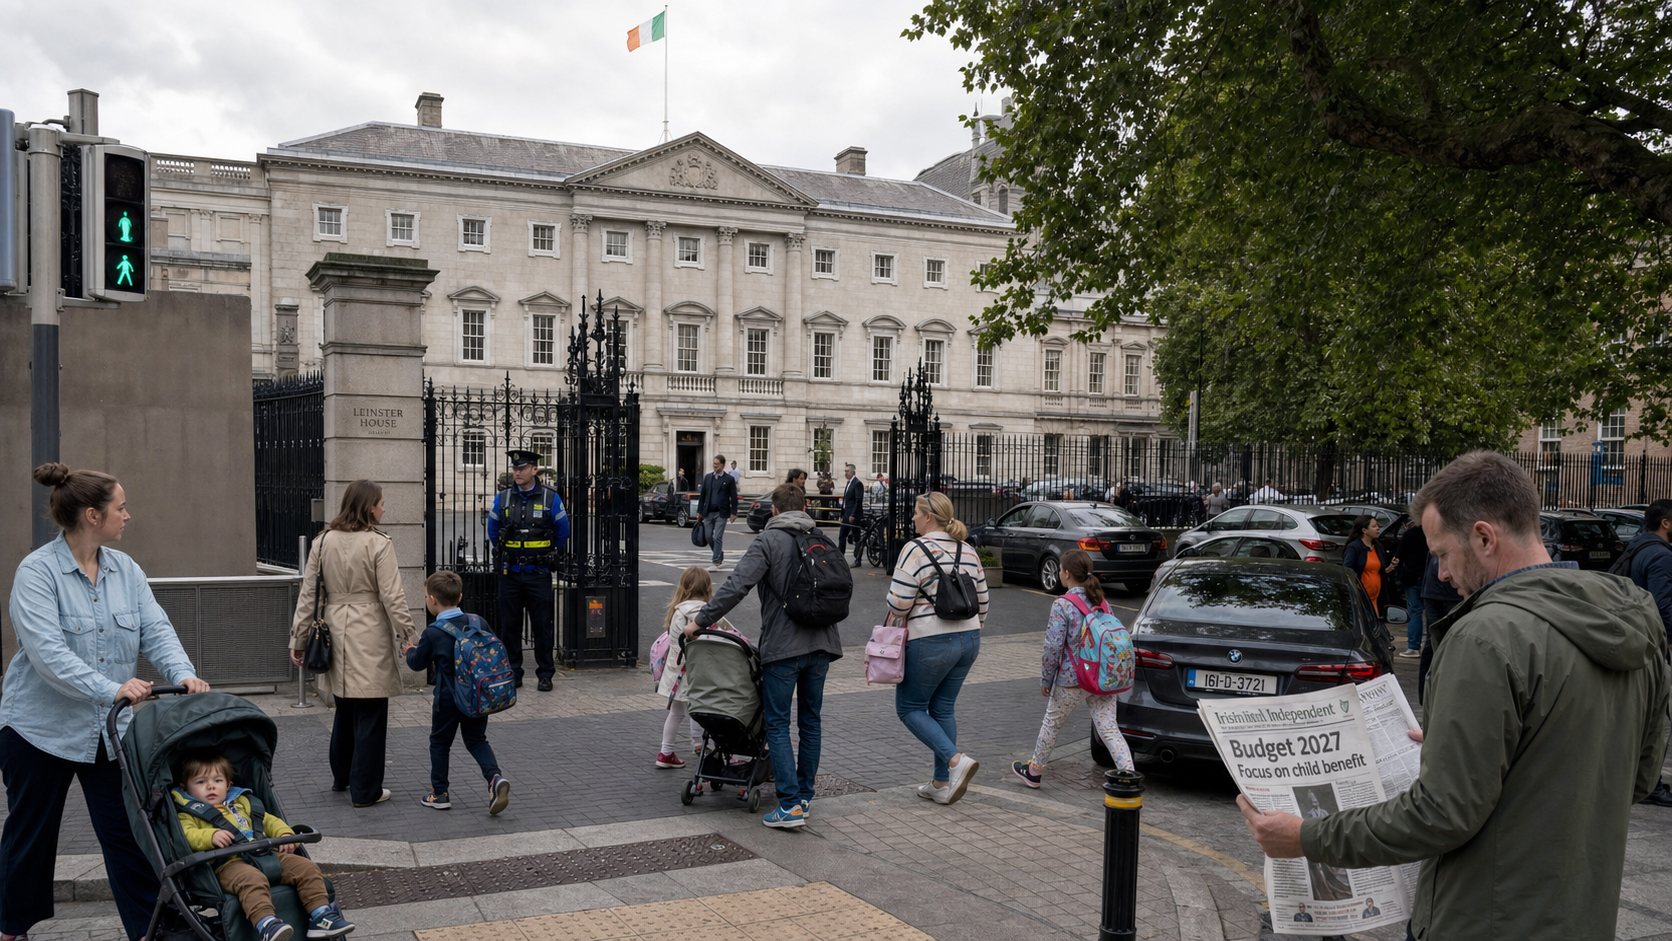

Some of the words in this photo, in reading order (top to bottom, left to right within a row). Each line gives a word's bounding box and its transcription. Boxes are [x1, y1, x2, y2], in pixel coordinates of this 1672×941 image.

[353, 408, 403, 417] LEINSTER
[360, 418, 397, 428] HOUSE
[1204, 674, 1265, 692] 161-D-3721
[1266, 703, 1336, 723] Independent
[1229, 737, 1296, 763] Budget
[1297, 731, 1341, 756] 2027
[1237, 763, 1273, 779] Focus
[1274, 766, 1291, 778] on
[1292, 760, 1321, 777] child
[1321, 753, 1367, 774] benefit
